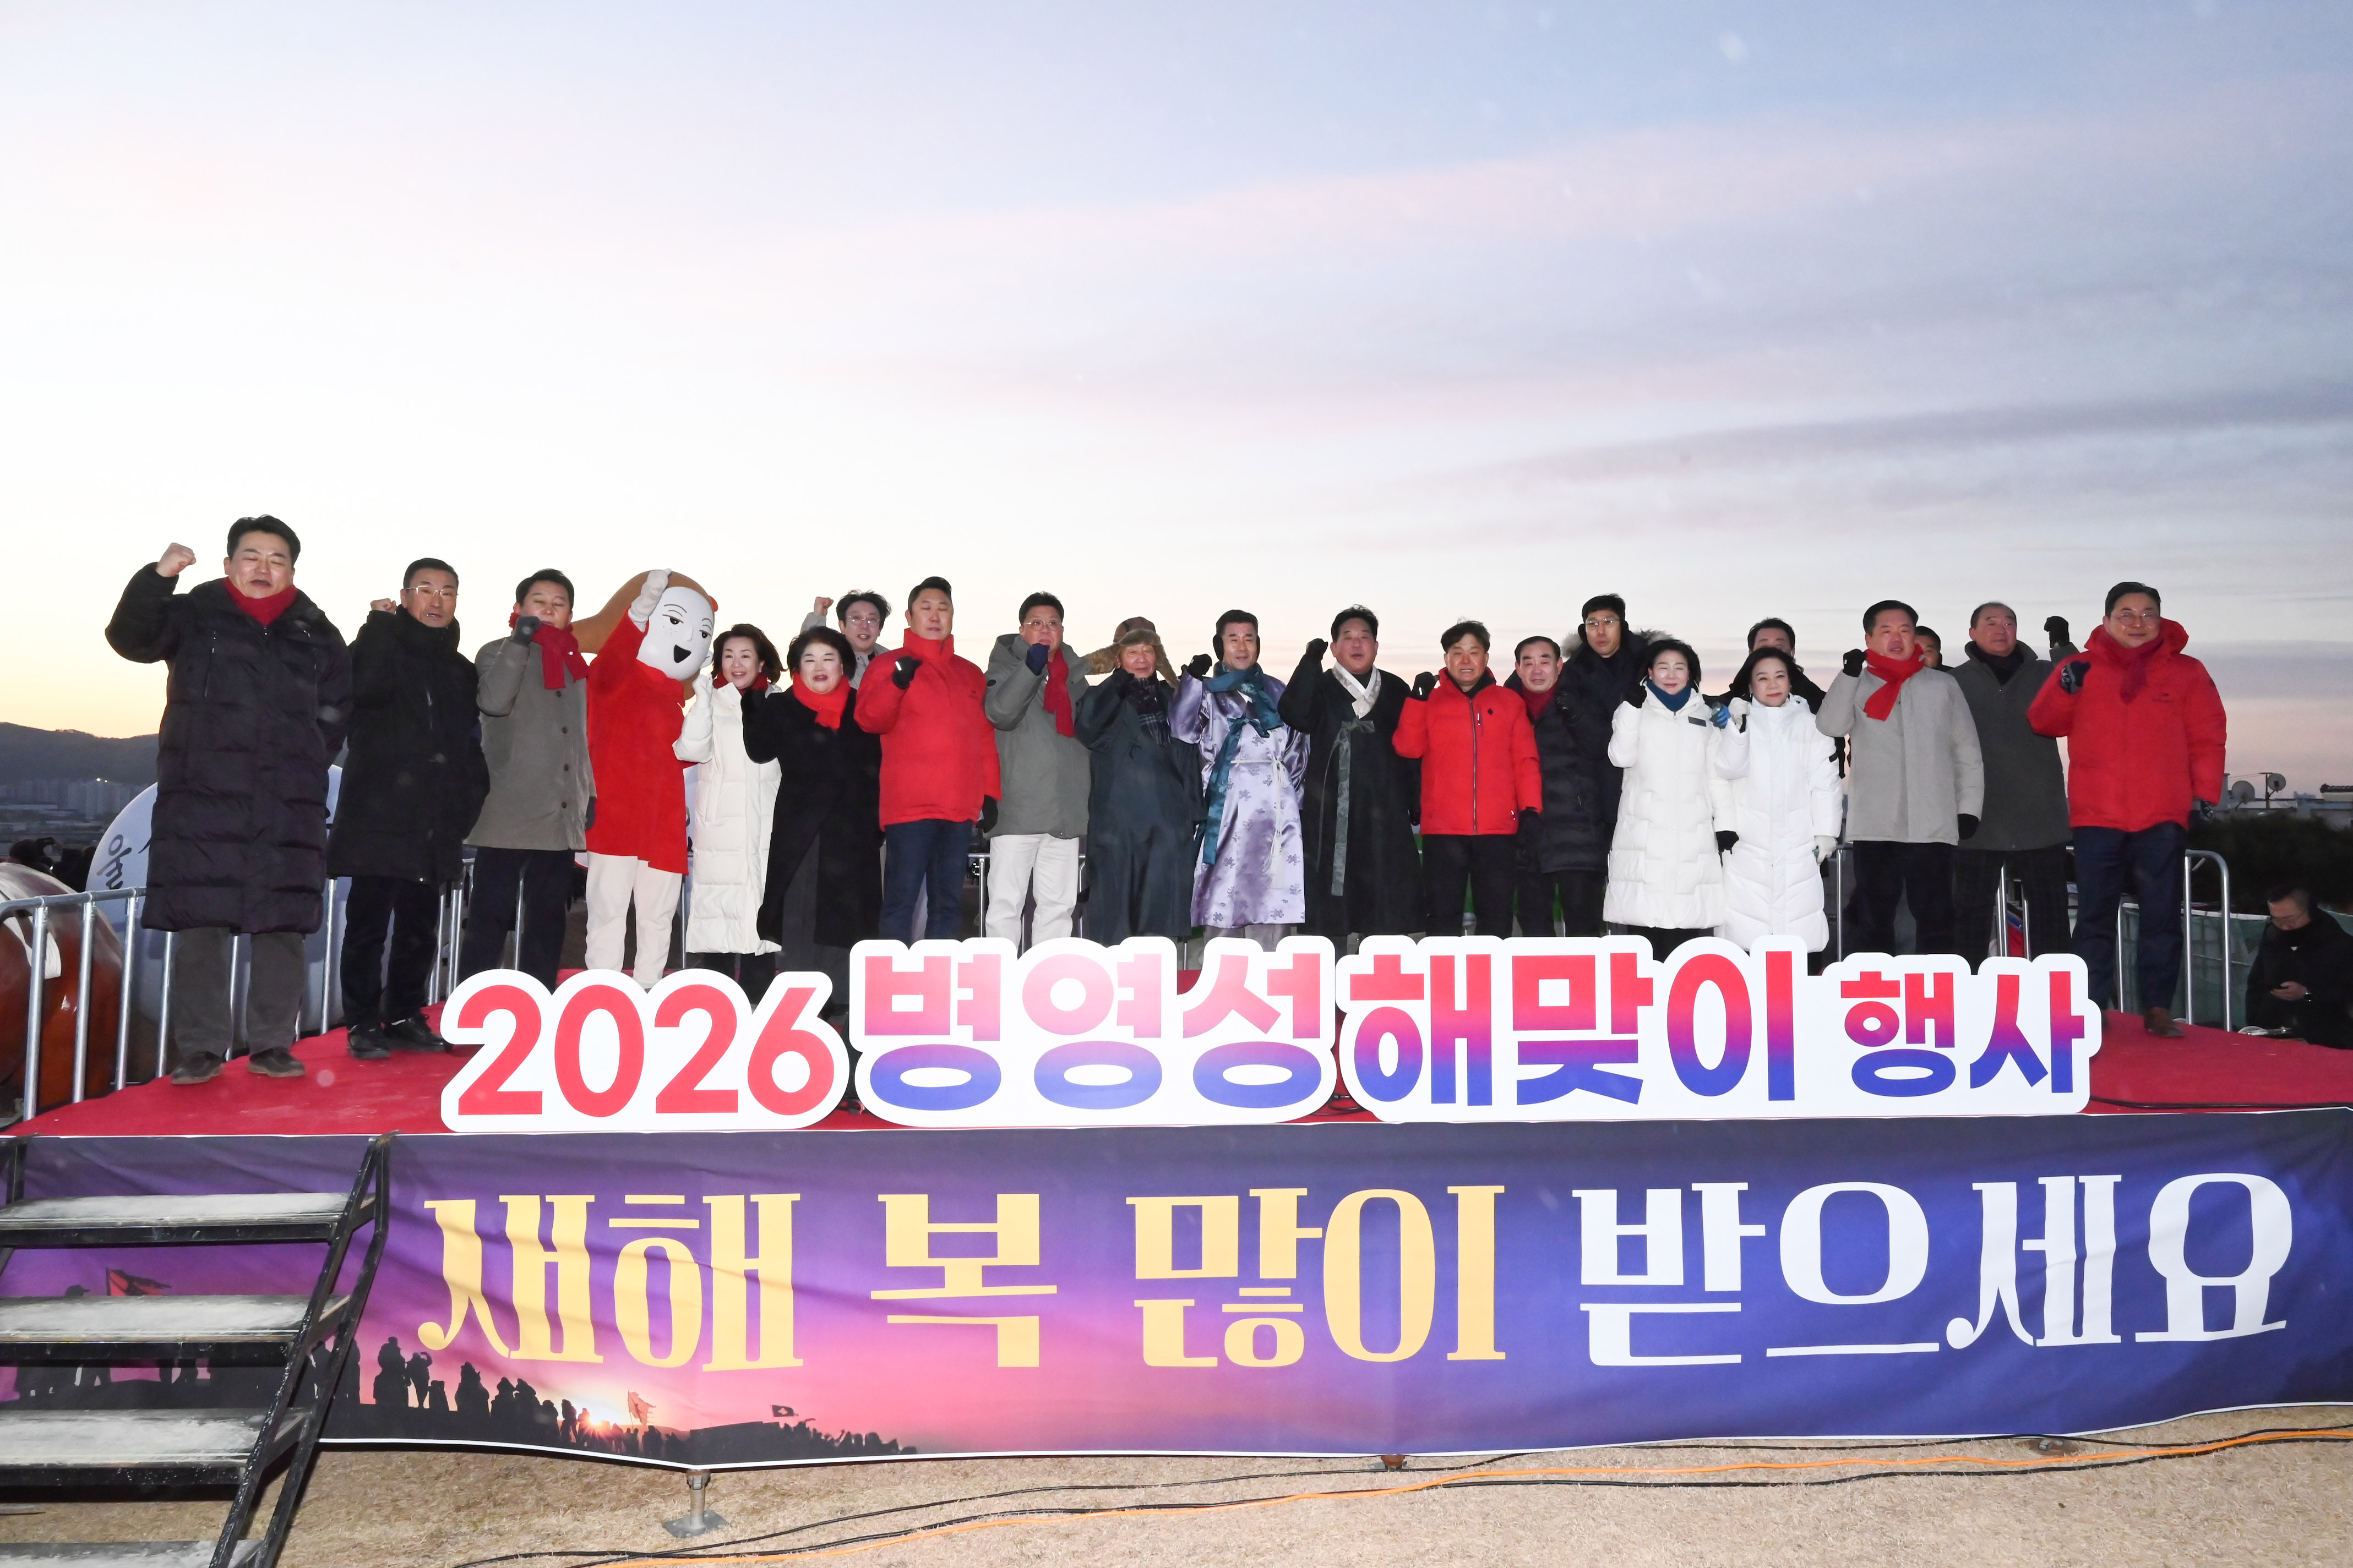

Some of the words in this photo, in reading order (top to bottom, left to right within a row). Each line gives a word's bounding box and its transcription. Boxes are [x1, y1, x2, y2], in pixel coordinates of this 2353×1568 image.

[457, 984, 835, 1117] 2026
[864, 953, 1322, 1111] 병영성
[1350, 951, 1795, 1106] 해맞이
[1840, 971, 2084, 1097] 행사
[418, 1193, 803, 1372] 새해
[870, 1193, 1058, 1367] 복
[1126, 1185, 1506, 1367] 많이
[1572, 1173, 2292, 1366] 받으세요
